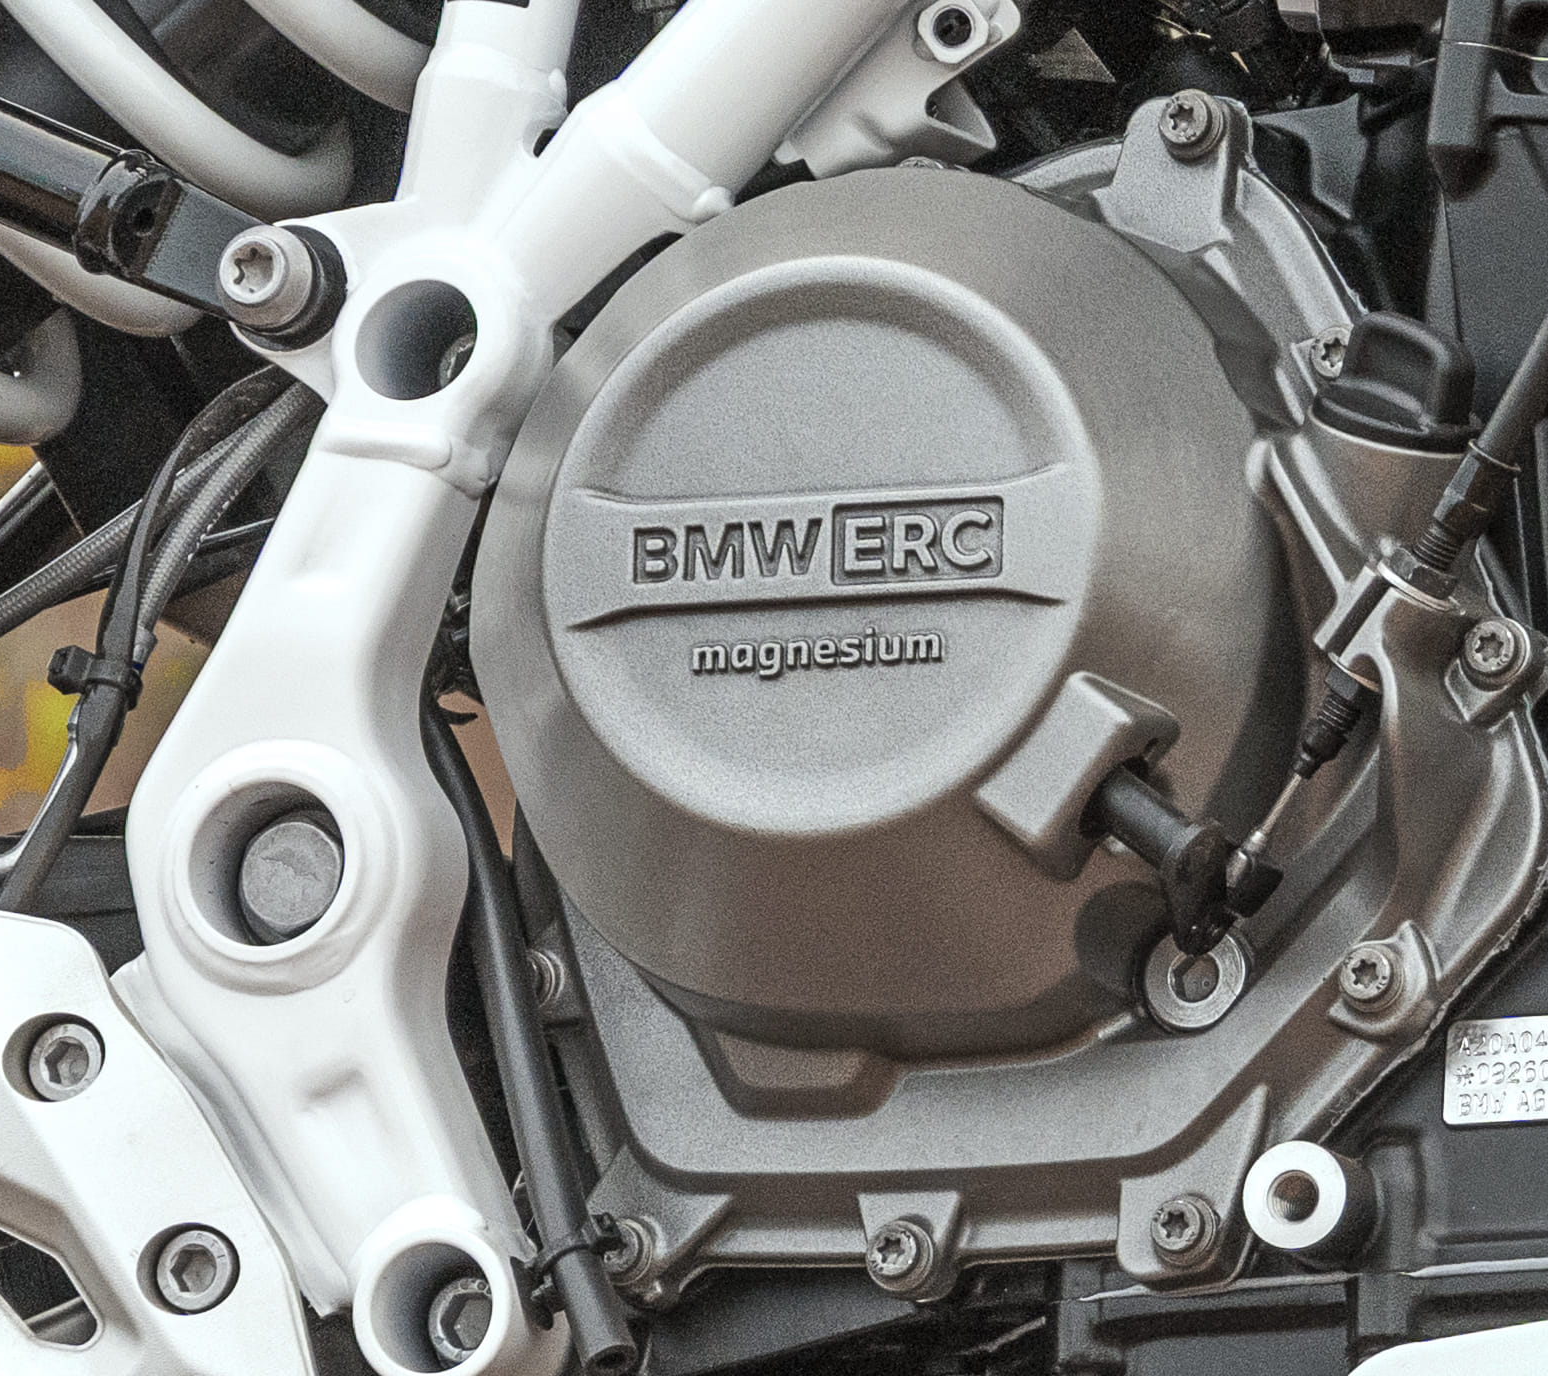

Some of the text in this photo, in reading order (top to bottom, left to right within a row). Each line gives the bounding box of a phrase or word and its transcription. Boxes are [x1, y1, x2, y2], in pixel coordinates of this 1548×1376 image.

[632, 508, 996, 585] BMW ERC
[691, 626, 944, 681] magnesium
[1457, 1090, 1507, 1117] BMW
[1516, 1088, 1546, 1112] AG
